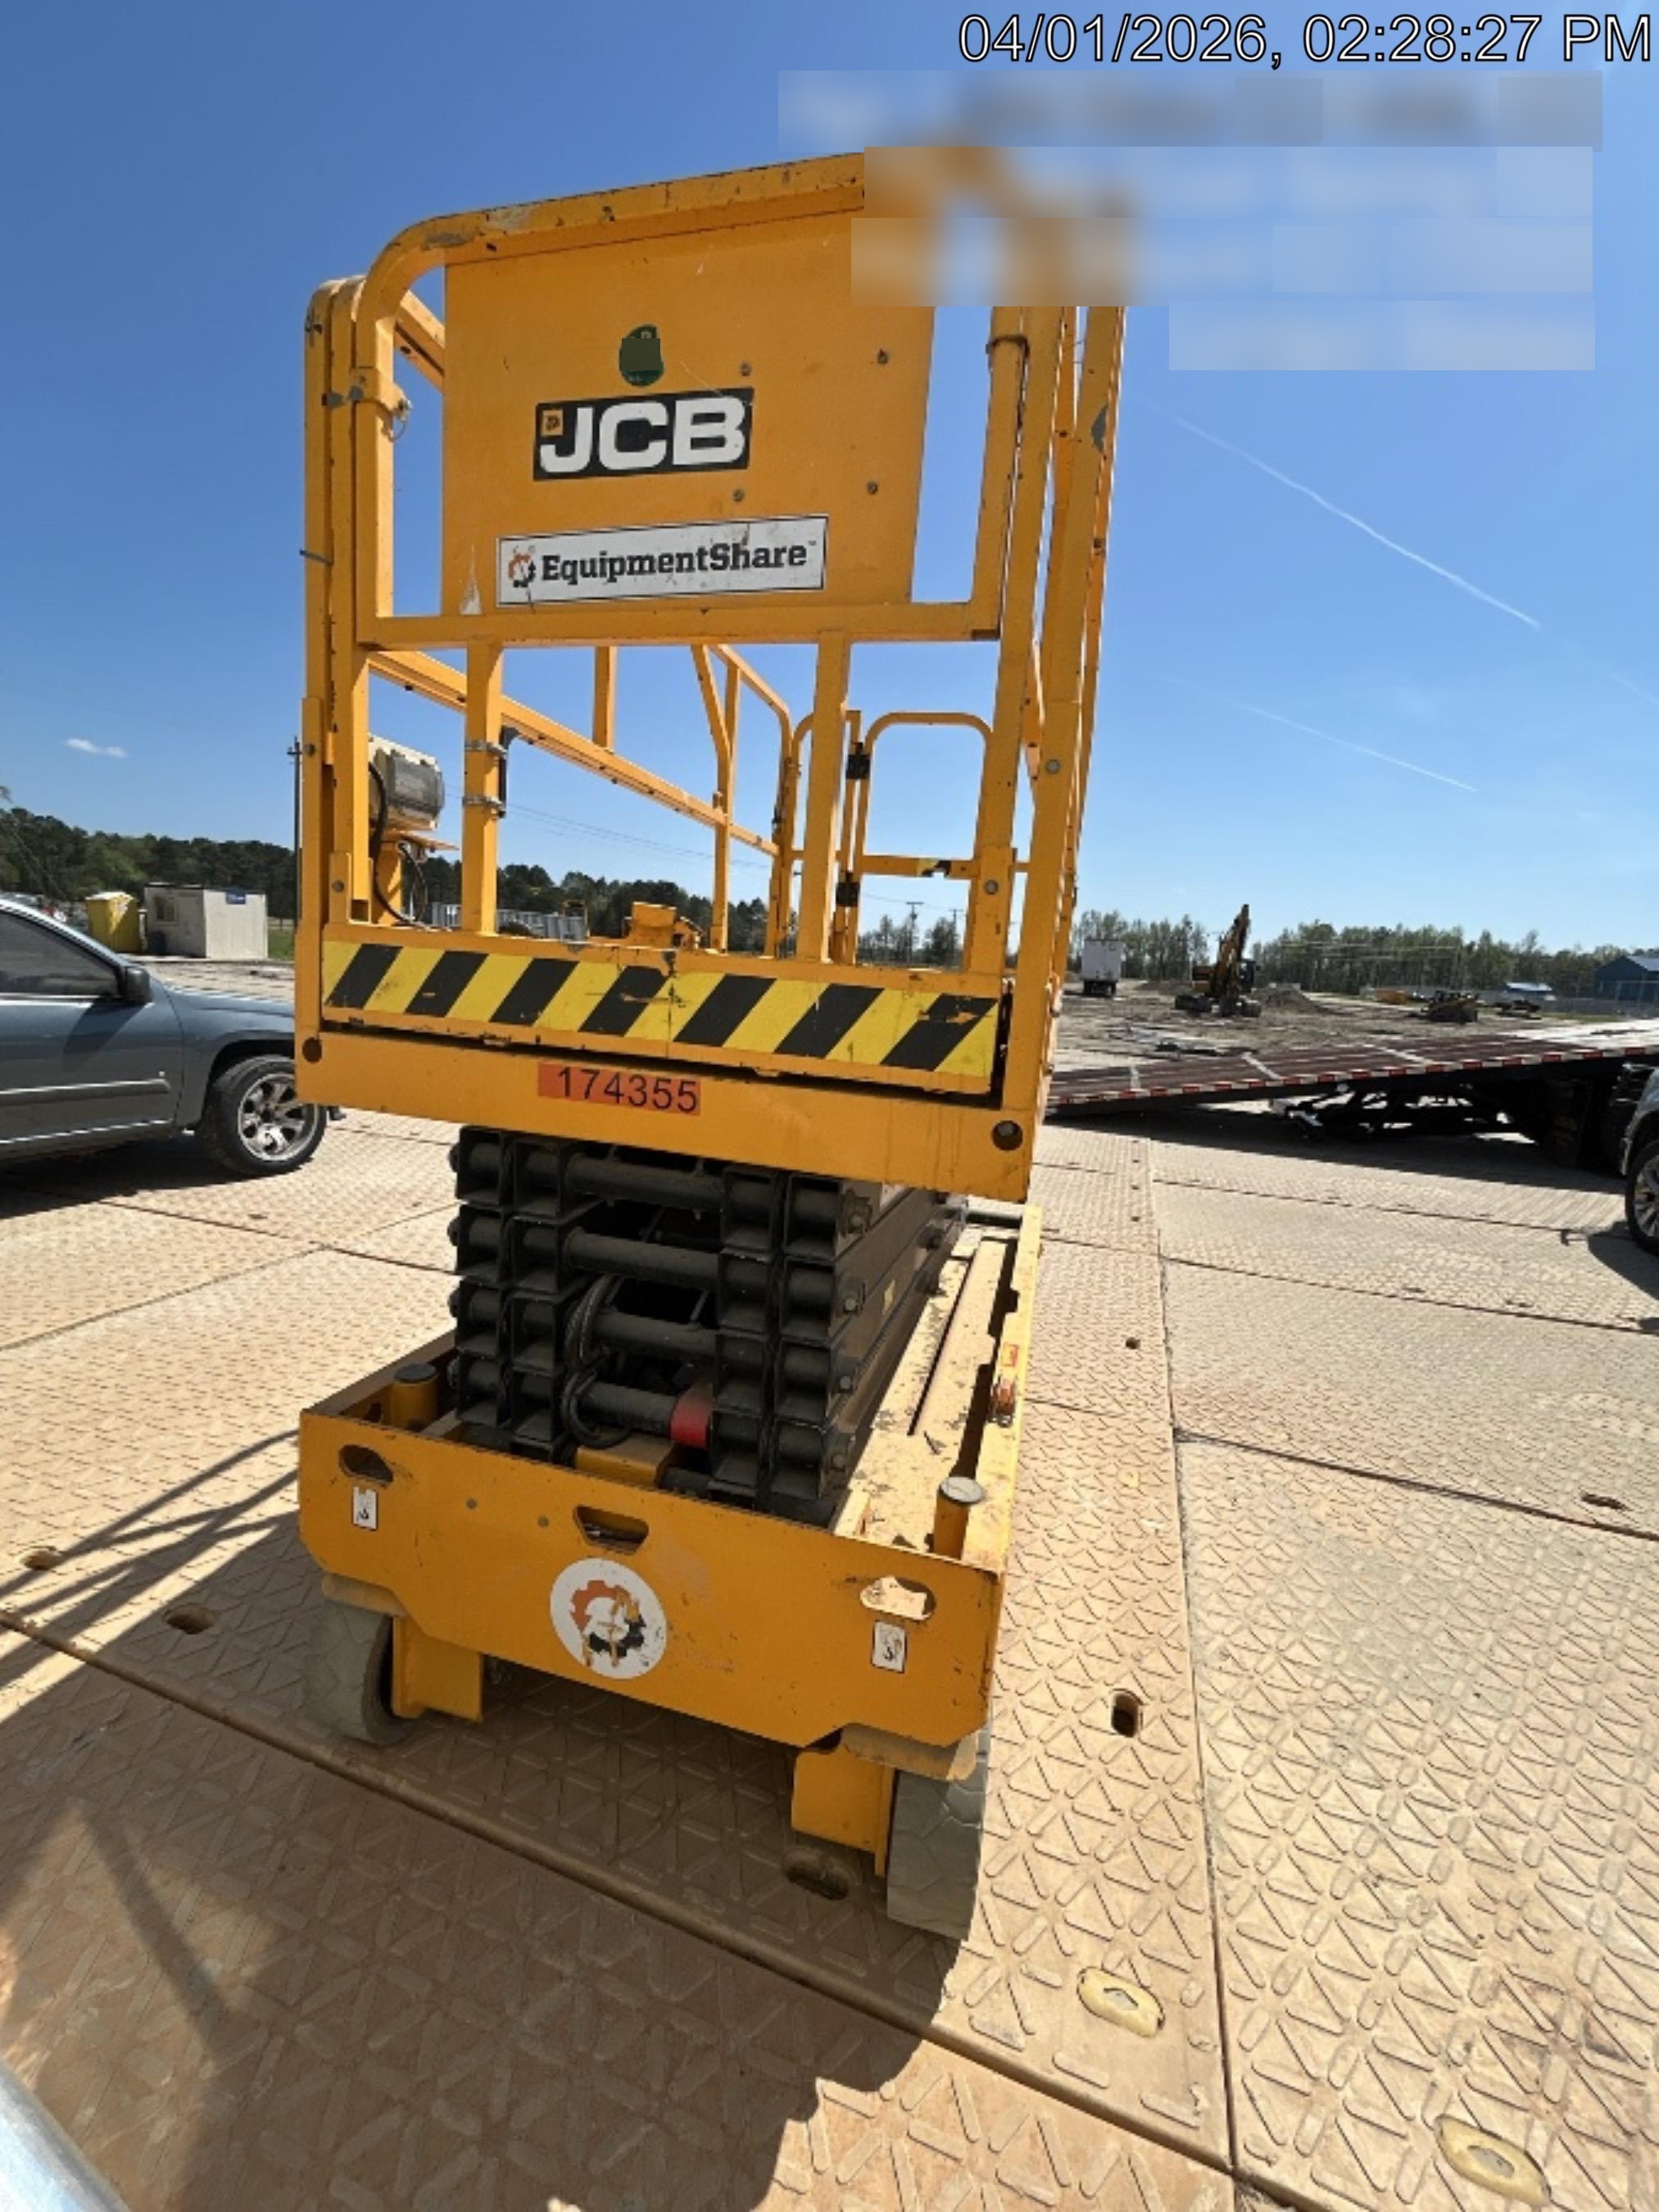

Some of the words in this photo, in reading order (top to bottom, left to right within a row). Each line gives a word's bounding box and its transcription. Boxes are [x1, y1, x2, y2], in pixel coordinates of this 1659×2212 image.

[539, 396, 746, 474] JCB
[541, 543, 808, 587] EquipmentShare
[558, 1066, 697, 1113] 174355
